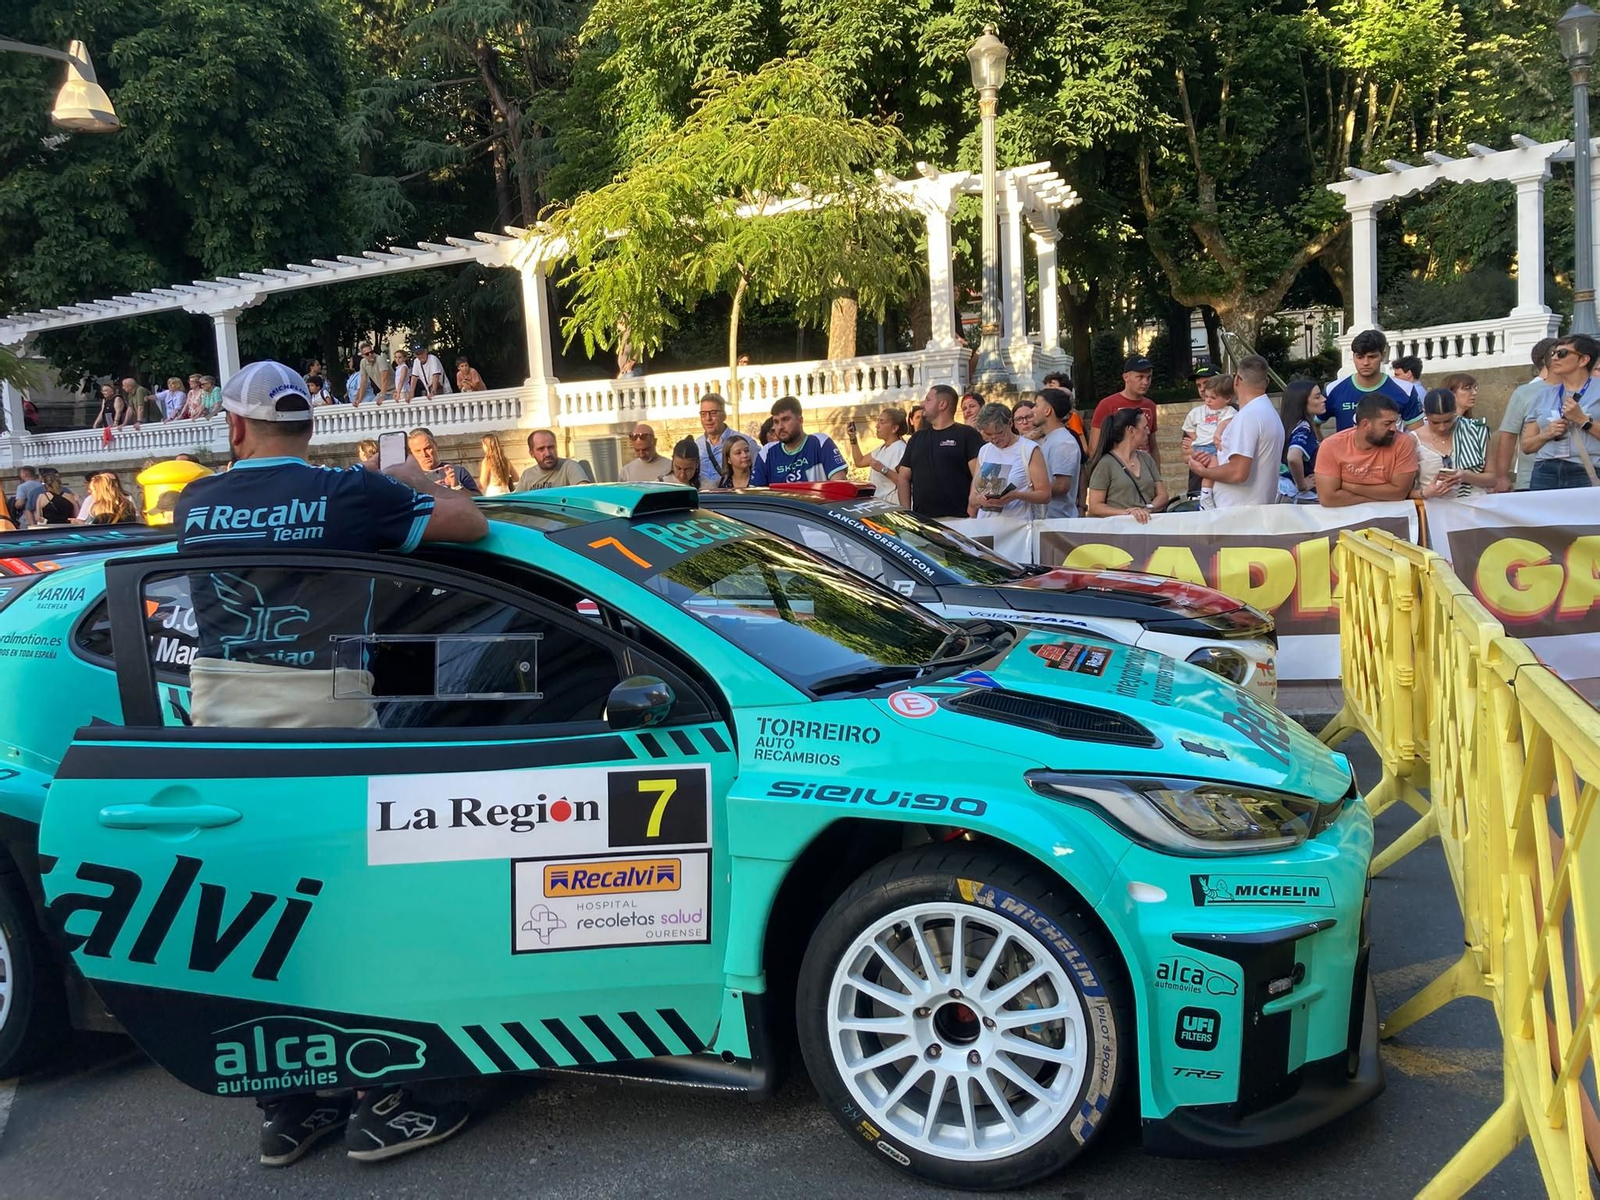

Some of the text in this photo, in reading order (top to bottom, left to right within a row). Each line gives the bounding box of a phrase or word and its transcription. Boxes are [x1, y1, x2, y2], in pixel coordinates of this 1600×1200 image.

[268, 384, 308, 400] MICHELIN
[209, 496, 328, 531] Recalvi
[273, 526, 325, 542] Team
[827, 510, 936, 578] LANCIA-CORSEHF.COM
[36, 587, 86, 601] MARINA
[901, 697, 926, 711] E
[756, 717, 881, 745] TORREIRO
[755, 737, 795, 750] AUTO
[754, 749, 842, 767] RECAMBIOS
[375, 793, 601, 833] La Región
[637, 778, 678, 838] 7
[570, 865, 655, 890] Recalvi
[1235, 885, 1320, 897] MICHELIN
[576, 899, 637, 911] HOSPITAL
[576, 908, 703, 931] recoletas salud
[645, 928, 703, 939] OURENSE
[1000, 896, 1098, 988] MICHELIN
[1156, 959, 1205, 986] alca
[1183, 1015, 1215, 1032] UFI
[1097, 1003, 1112, 1085] PILOT SPORT
[1181, 1031, 1213, 1043] FILTERS
[214, 1025, 337, 1076] alca
[216, 1070, 338, 1094] automóviles
[1172, 1066, 1225, 1080] TRS
